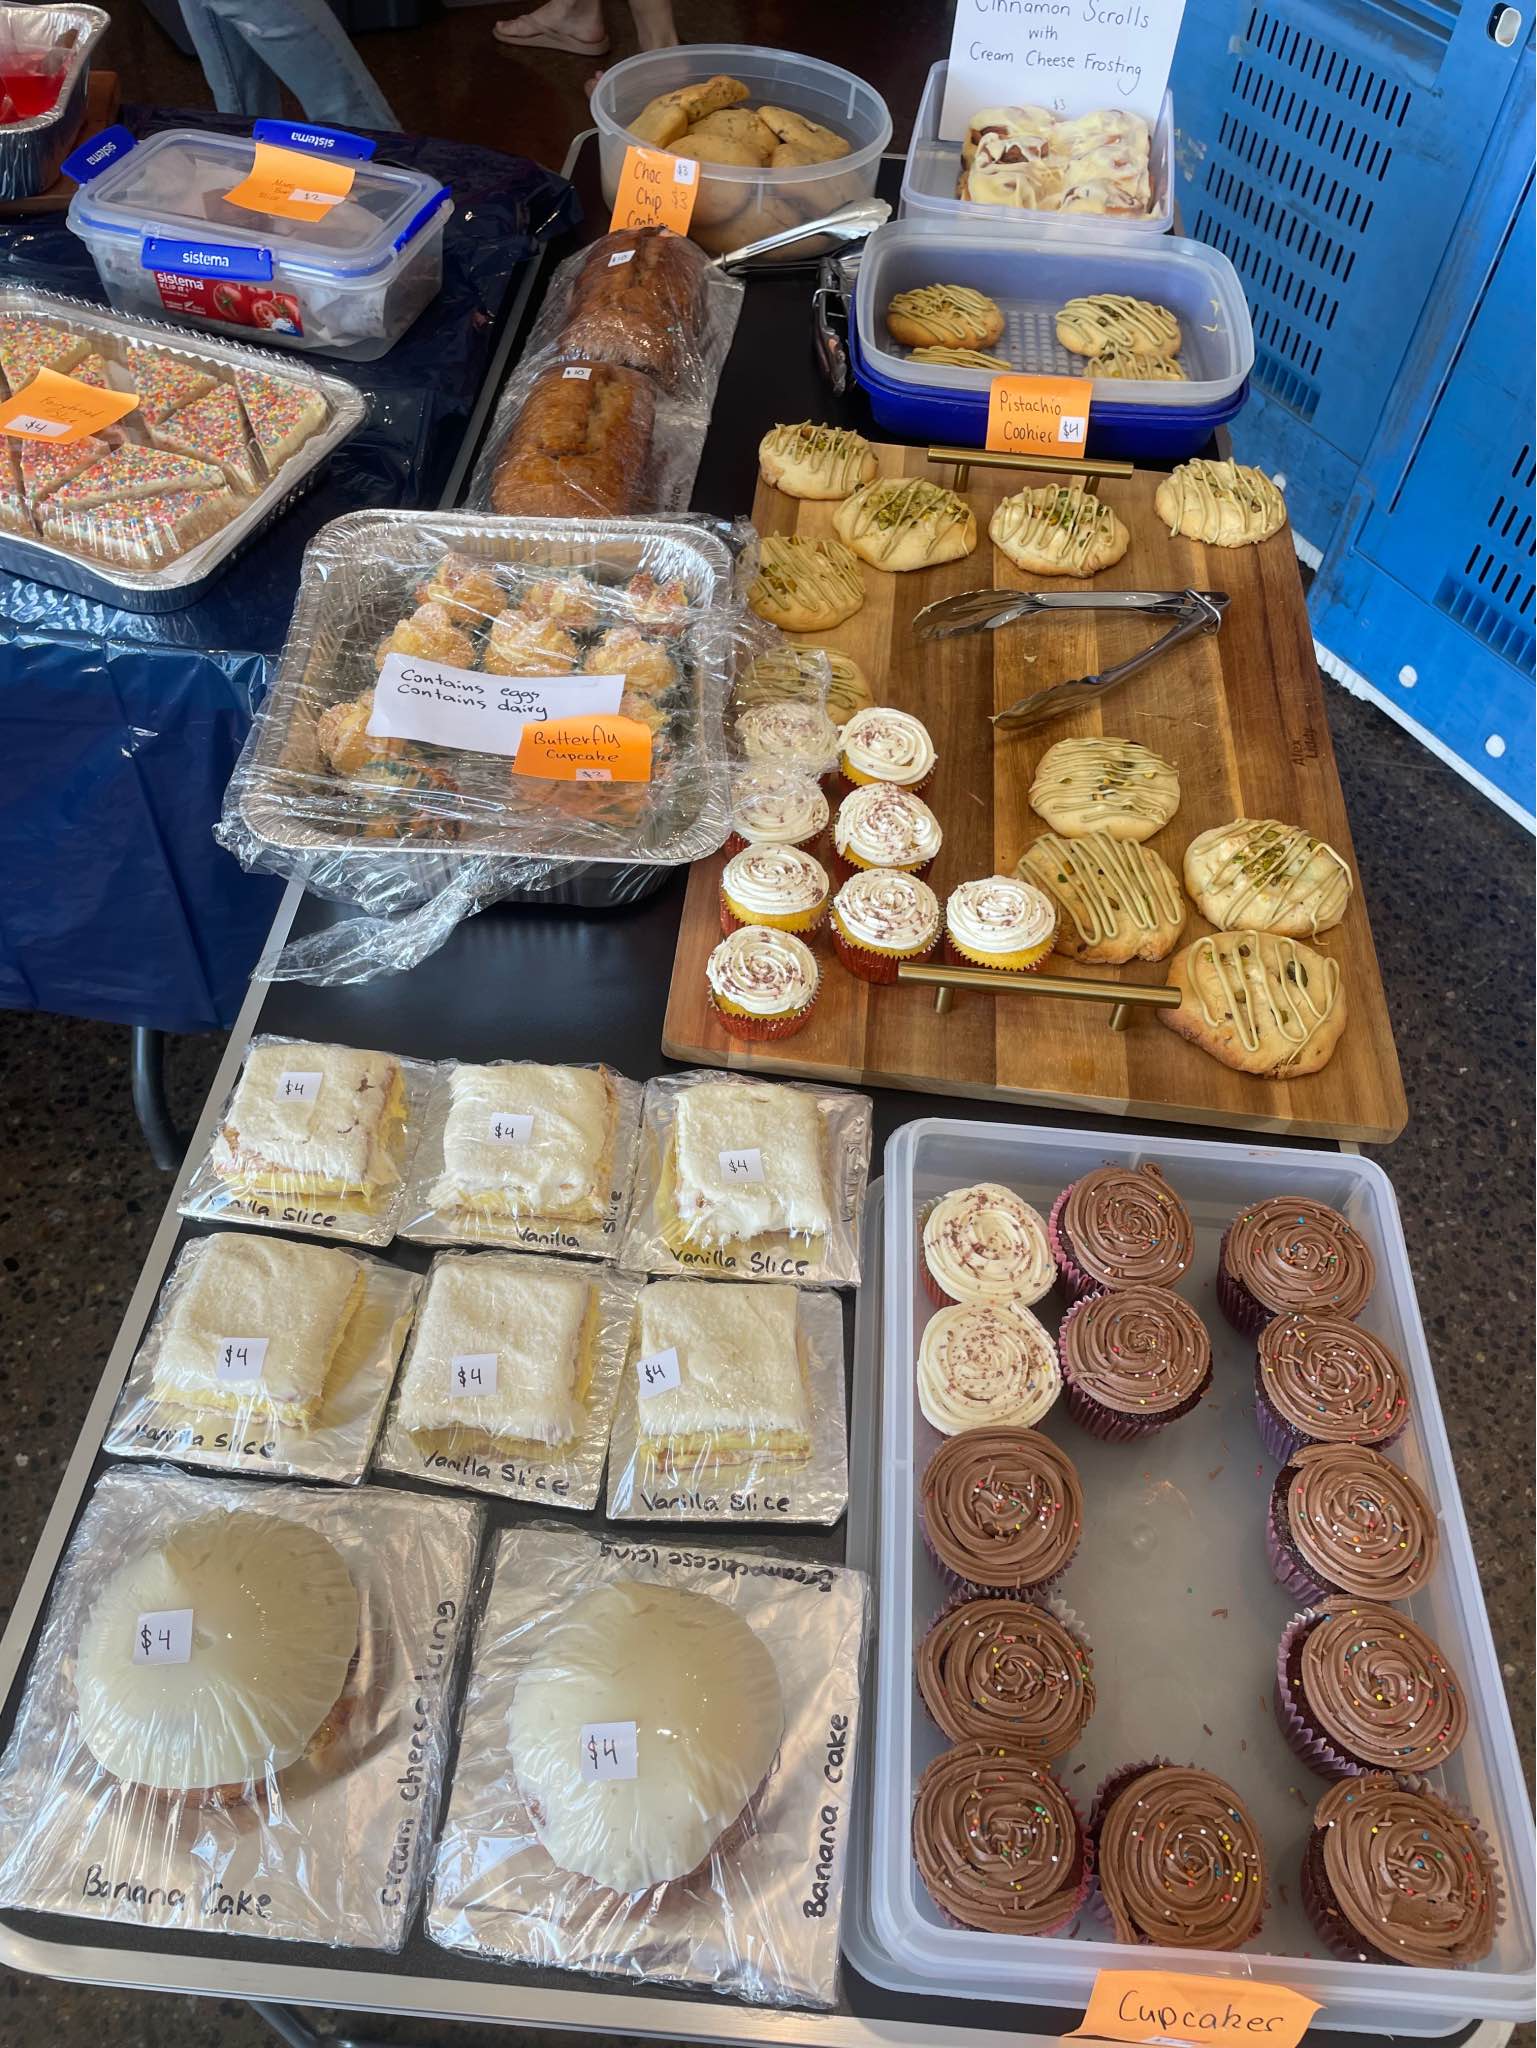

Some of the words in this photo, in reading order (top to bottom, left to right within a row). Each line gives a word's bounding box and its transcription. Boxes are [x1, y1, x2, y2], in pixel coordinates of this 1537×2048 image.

[975, 0, 1071, 17] Cinnamon
[1083, 0, 1149, 28] Scrolls
[1029, 25, 1059, 41] with
[970, 41, 1014, 63] Cream
[1026, 50, 1075, 69] Cheese
[1085, 53, 1142, 88] Frosting
[1053, 98, 1066, 111] $3
[291, 131, 335, 149] sistema
[86, 141, 117, 166] sistema
[634, 161, 663, 185] Choc
[636, 187, 662, 215] Chip
[671, 190, 688, 210] $3
[182, 250, 230, 268] sistema
[157, 272, 205, 291] sistema
[1000, 390, 1062, 416] Pistachio
[25, 420, 47, 432] $4
[1063, 421, 1079, 439] $4
[401, 669, 485, 695] Contains
[501, 687, 540, 704] eggs
[397, 684, 487, 710] Contains
[497, 699, 548, 721] dairy
[534, 724, 621, 749] Butterfly
[546, 750, 620, 764] Cupcake
[285, 1079, 304, 1096] $4
[494, 1121, 515, 1139] $4
[728, 1159, 748, 1174] $4
[282, 1207, 337, 1227] Slice
[518, 1226, 581, 1248] Vanilla
[602, 1191, 623, 1234] Slice
[671, 1248, 737, 1269] Vanilla
[750, 1251, 810, 1277] Slice
[224, 1344, 248, 1368] $4
[457, 1366, 482, 1388] $4
[645, 1363, 666, 1384] $4
[423, 1450, 491, 1480] Vanilla
[501, 1463, 570, 1497] Slice
[641, 1491, 720, 1512] Vanilla
[730, 1491, 791, 1512] Slice
[140, 1623, 171, 1656] $4
[382, 1818, 415, 1908] Cream
[414, 1600, 456, 1681] Icing
[586, 1735, 618, 1770] $4
[803, 1805, 839, 1919] Banana
[82, 1863, 185, 1911] Banana
